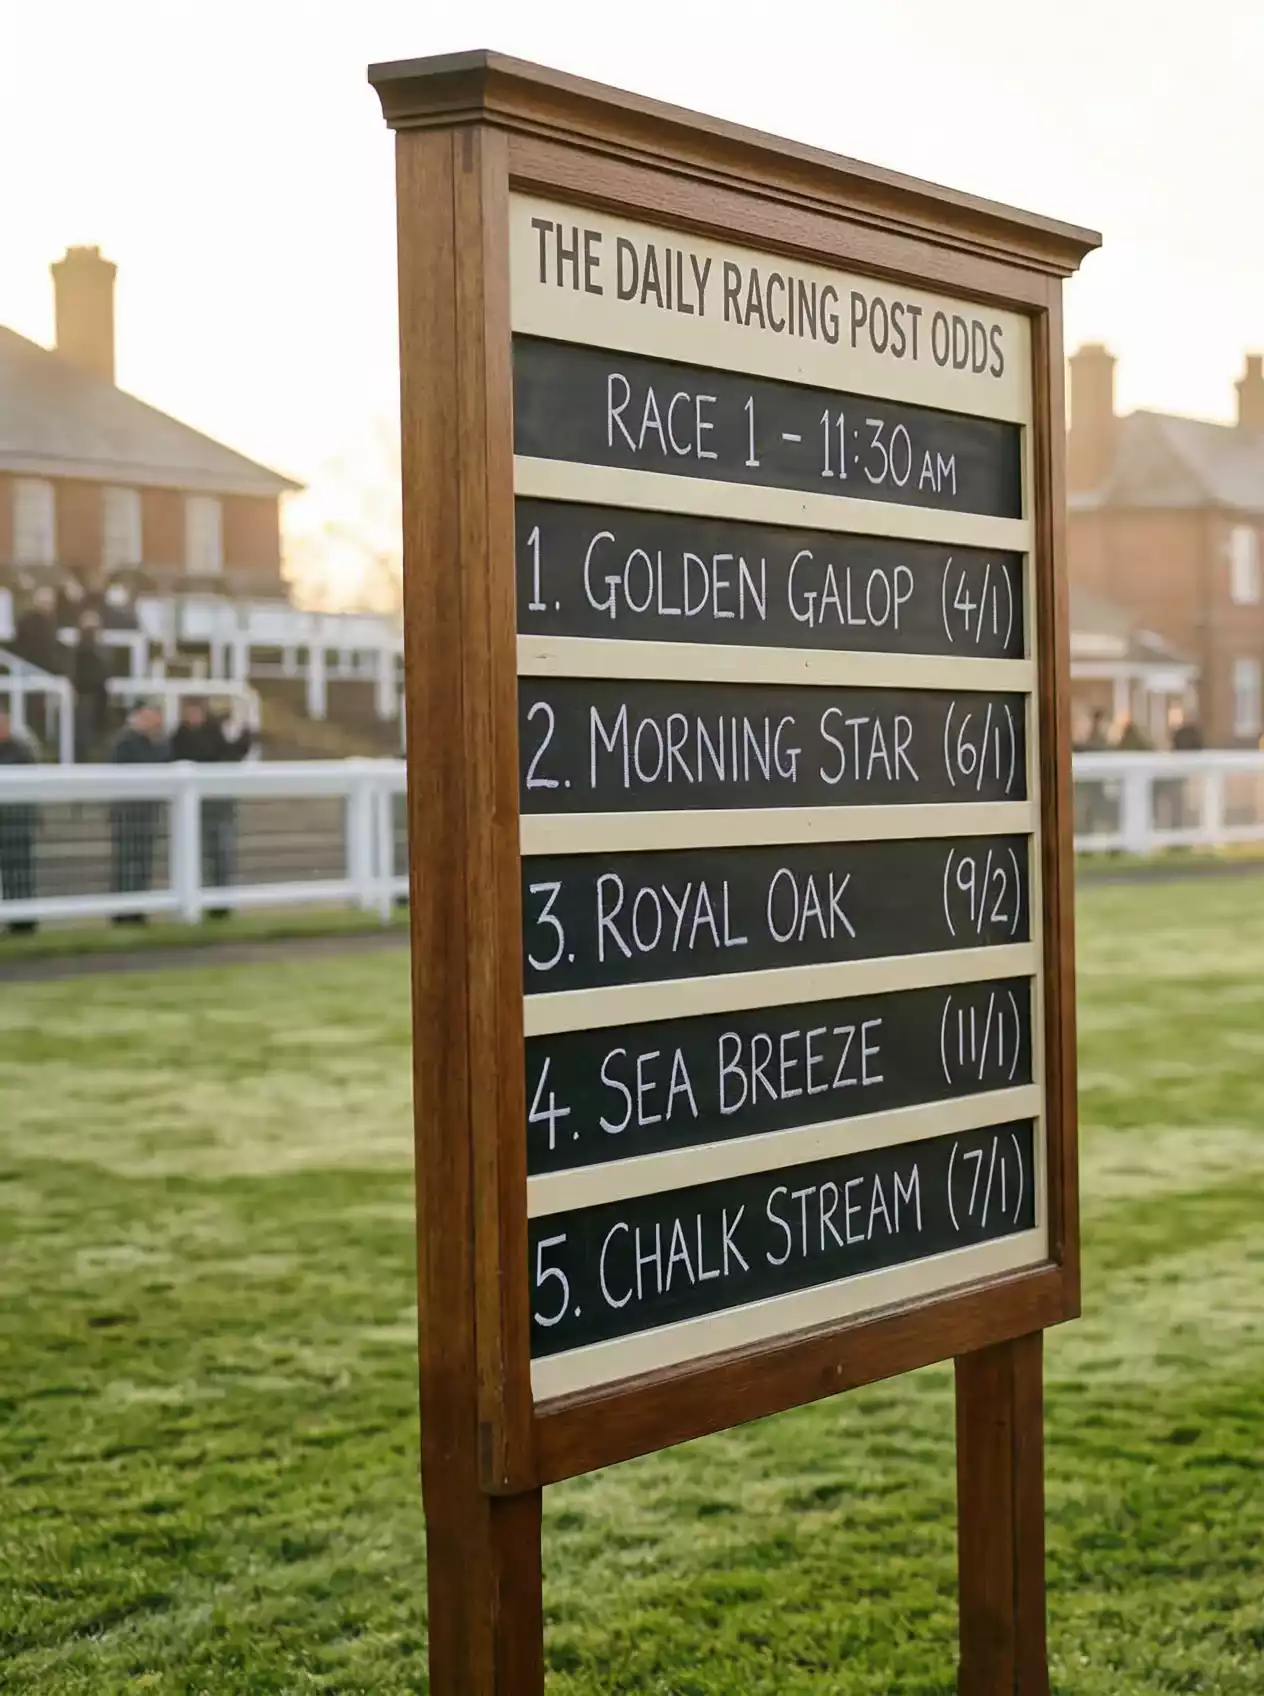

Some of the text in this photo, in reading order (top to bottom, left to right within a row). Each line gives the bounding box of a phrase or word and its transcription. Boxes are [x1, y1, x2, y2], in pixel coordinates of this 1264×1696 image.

[531, 218, 1004, 378] THE DAILY RACING POST ODDS
[607, 373, 718, 460] RACE
[744, 395, 760, 467] 1
[819, 410, 912, 487] 11:30
[919, 450, 957, 495] AM
[527, 526, 1013, 649] 1. GOLDEN GALOP (4/1)
[526, 700, 1016, 793] 2. MORNING STAR (6/1)
[528, 848, 1021, 971] 3. ROYAL OAK (9/2)
[528, 990, 1021, 1149] 4. SEA BREEZE (11/1)
[533, 1134, 1023, 1327] 5. CHALK STREAM (7/1)
